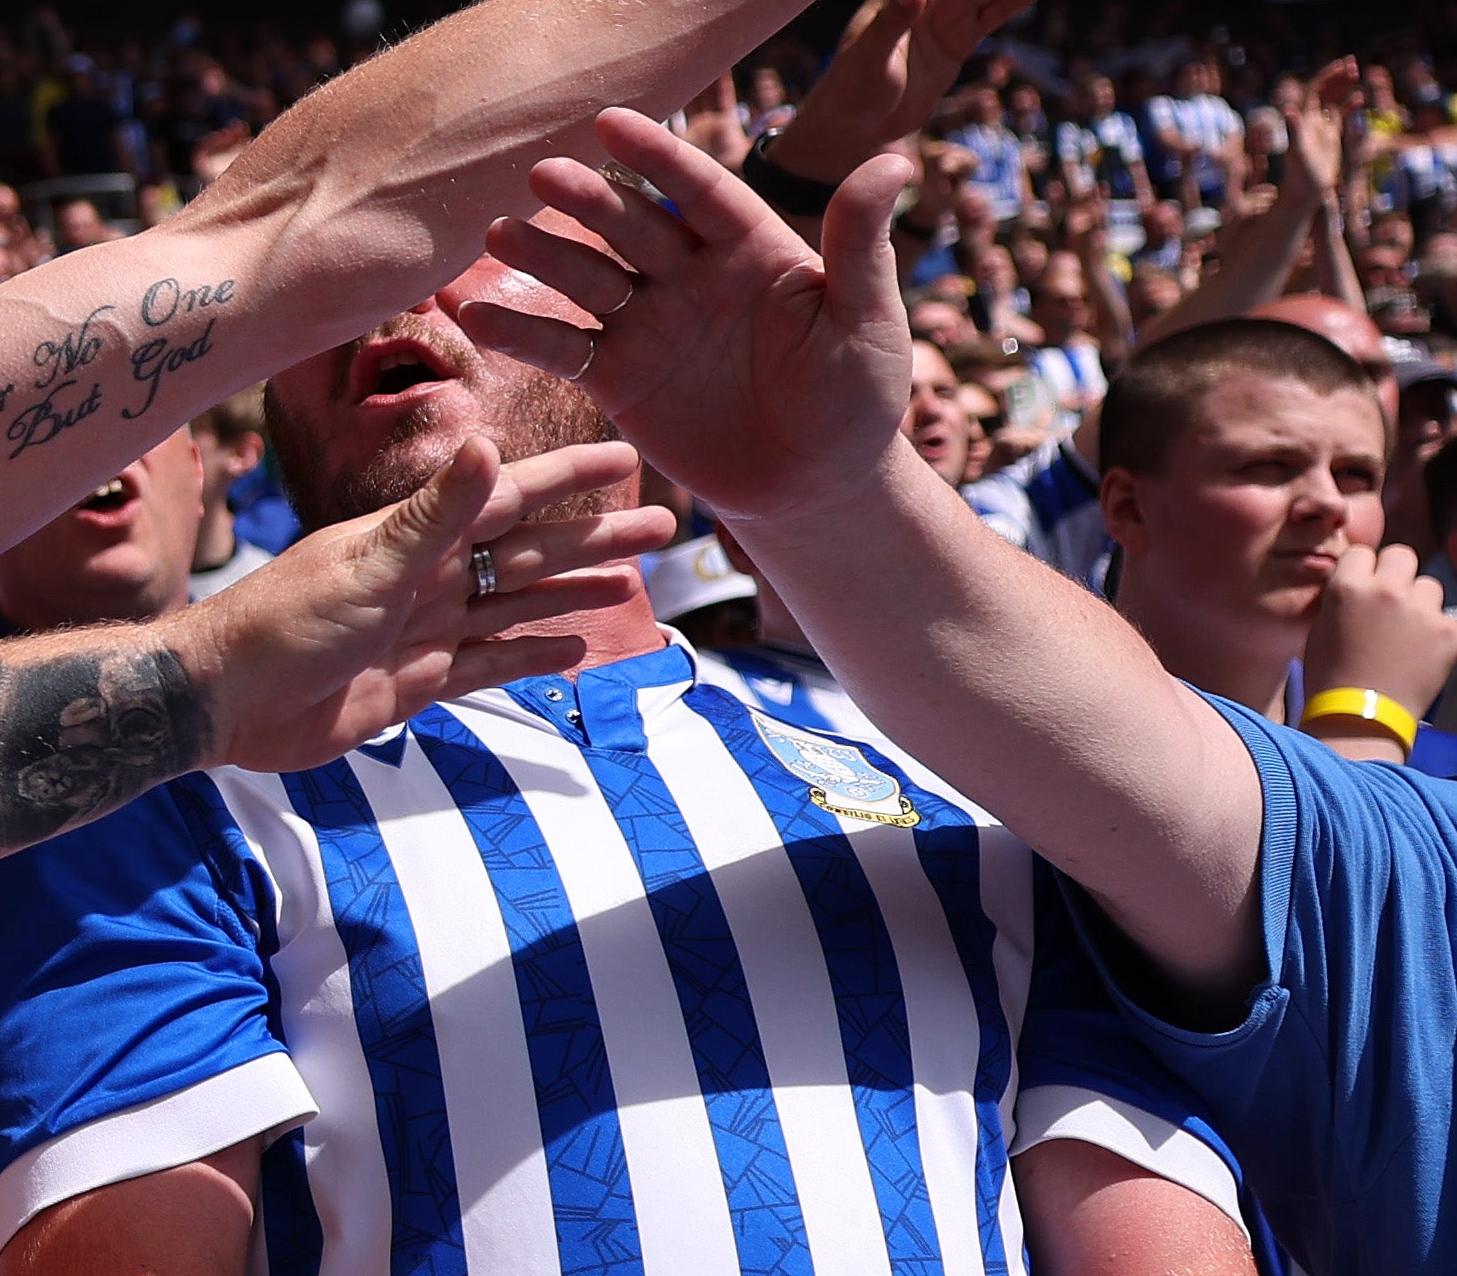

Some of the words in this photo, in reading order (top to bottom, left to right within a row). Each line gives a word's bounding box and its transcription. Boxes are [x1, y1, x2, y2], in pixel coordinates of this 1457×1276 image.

[7, 380, 102, 459] But
[122, 317, 216, 419] God
[33, 305, 115, 388] No
[141, 277, 235, 327] One
